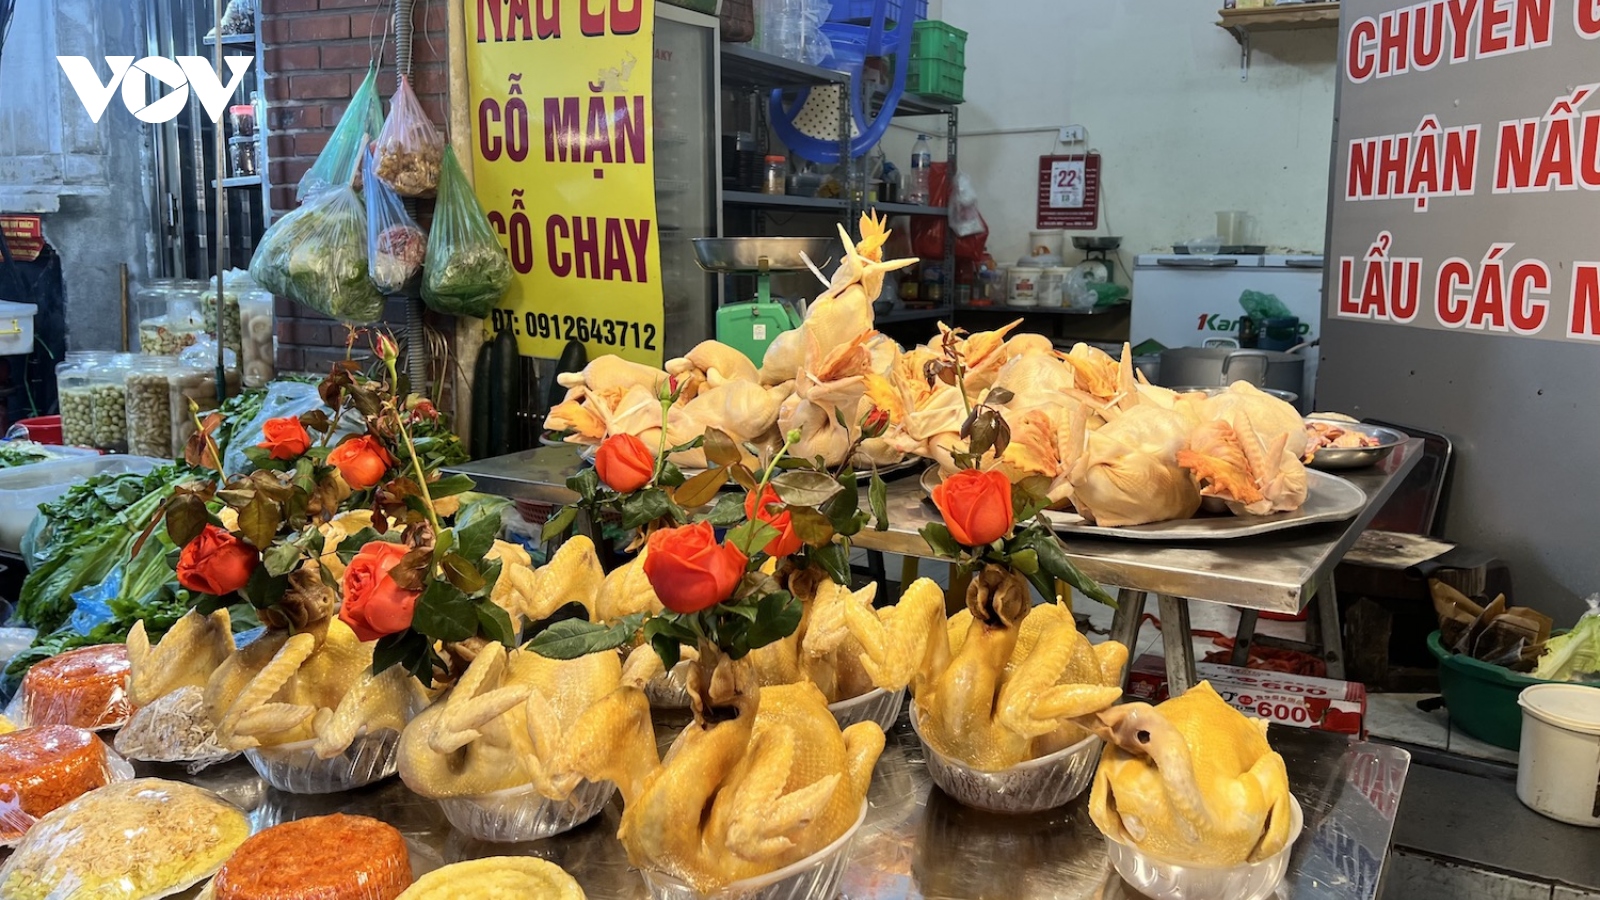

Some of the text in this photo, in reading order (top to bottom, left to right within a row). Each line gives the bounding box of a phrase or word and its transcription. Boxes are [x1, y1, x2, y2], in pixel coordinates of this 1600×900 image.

[478, 73, 646, 179] CỖ MẶN
[1057, 170, 1076, 187] 22
[1347, 117, 1479, 210] NHẬN
[545, 213, 651, 283] CHAY
[1339, 233, 1421, 321] LẨU
[1437, 246, 1548, 332] CÁC
[525, 311, 657, 351] 0912643712
[1257, 701, 1307, 723] 600
